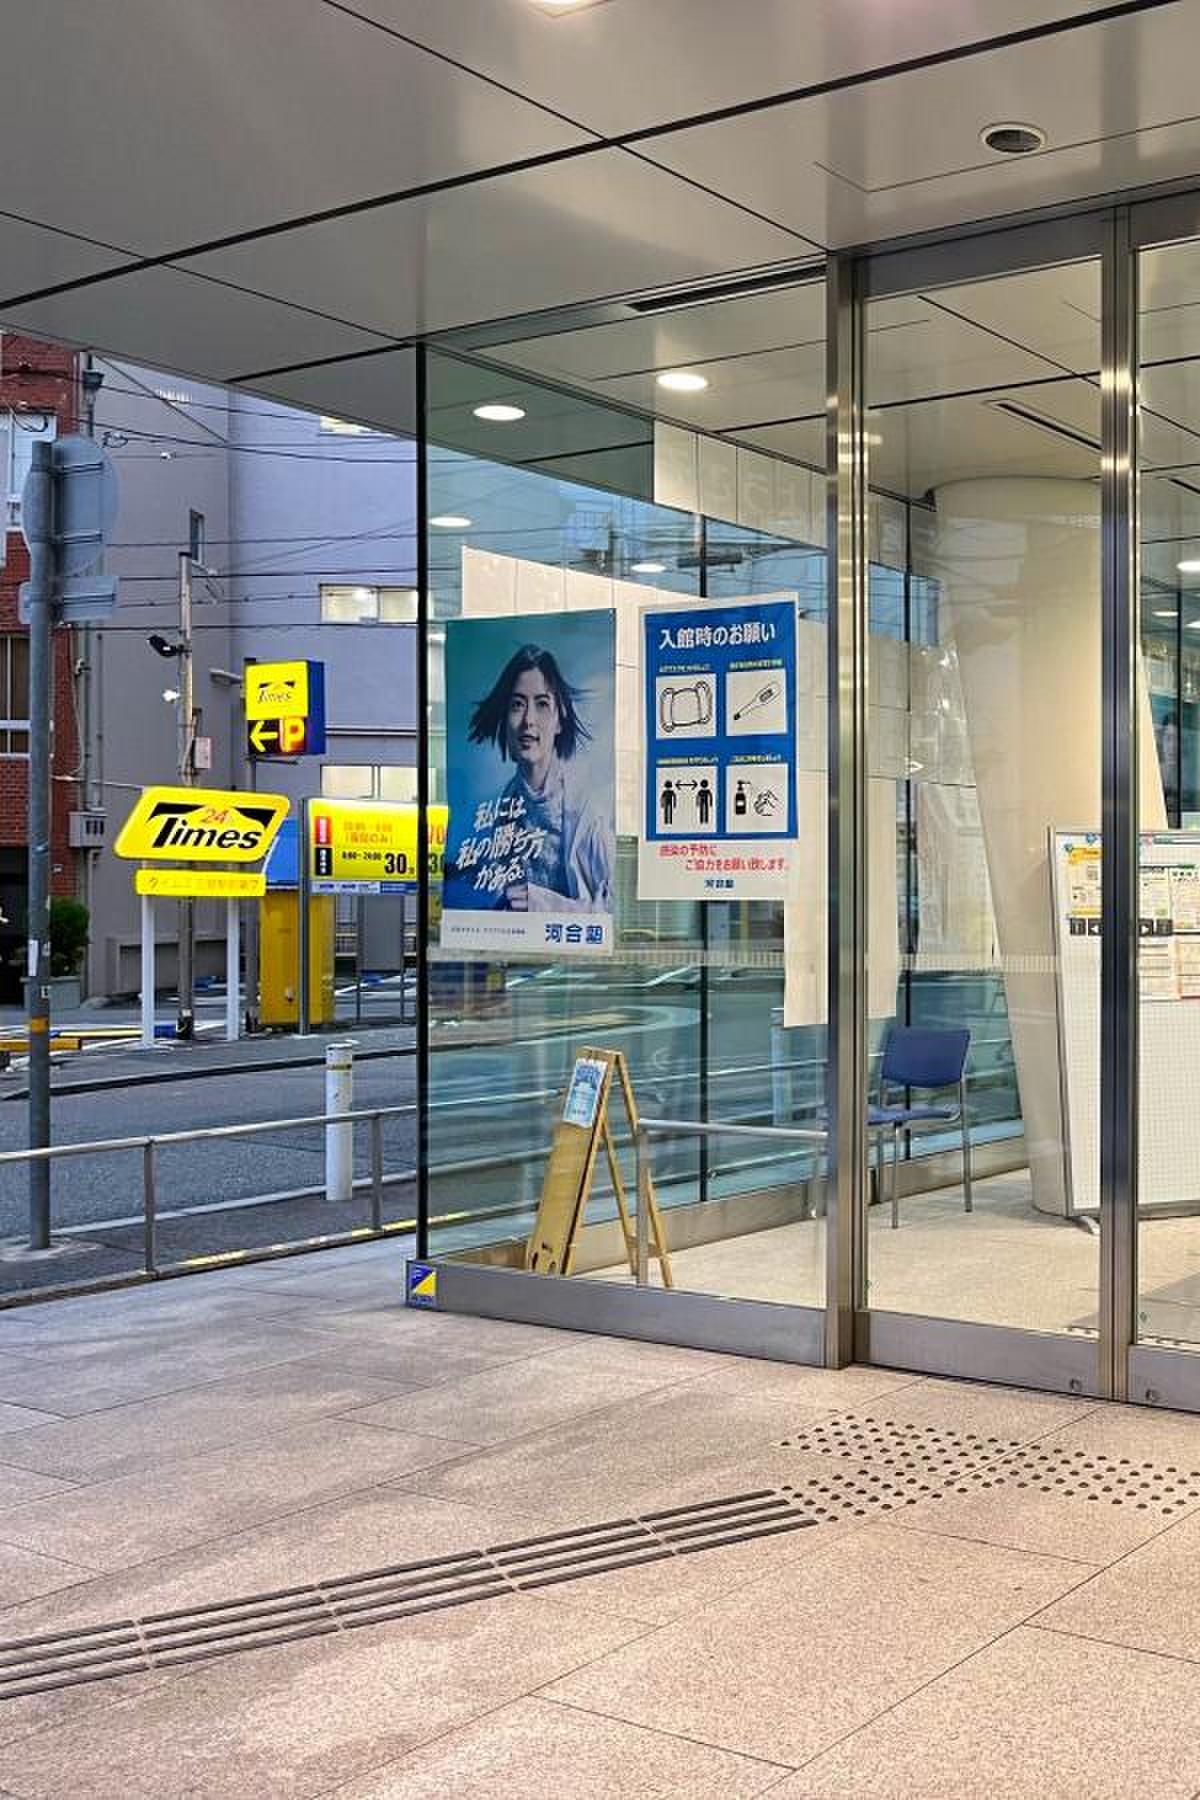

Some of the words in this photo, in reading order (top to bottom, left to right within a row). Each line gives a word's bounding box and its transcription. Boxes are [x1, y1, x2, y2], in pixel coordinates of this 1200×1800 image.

[659, 621, 776, 650] 入館時のお願い
[284, 718, 305, 752] P
[150, 812, 263, 848] Times
[473, 796, 527, 832] 私には
[545, 923, 604, 945] 河合塾
